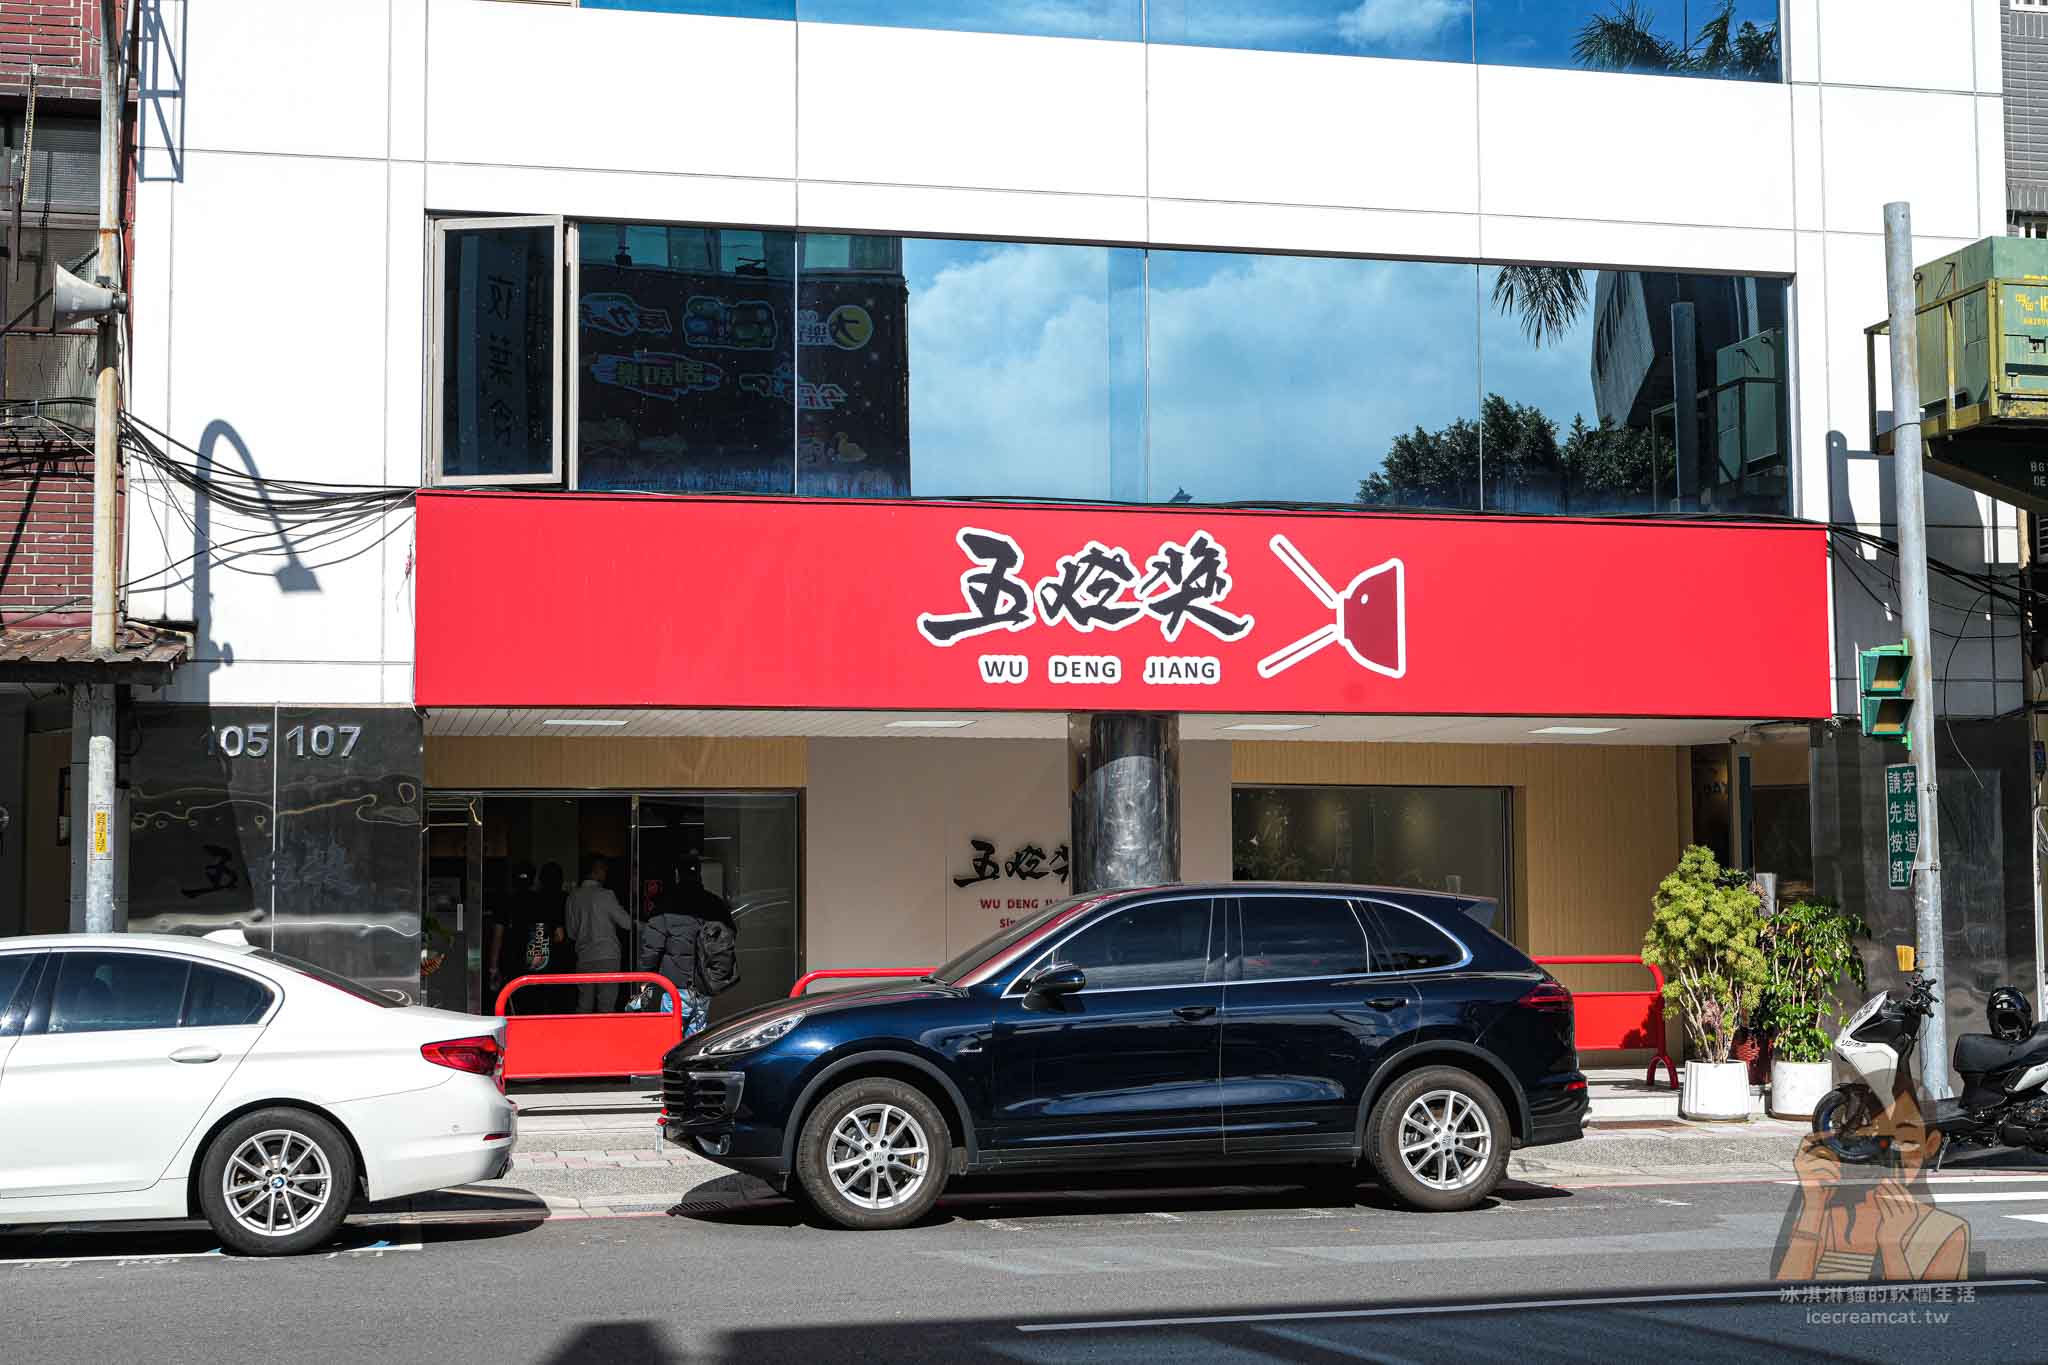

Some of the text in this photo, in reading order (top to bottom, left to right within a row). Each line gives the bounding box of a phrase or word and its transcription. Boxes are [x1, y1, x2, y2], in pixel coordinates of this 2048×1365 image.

[984, 660, 1216, 679] WU DENG JIANG
[286, 724, 361, 757] 107
[1887, 771, 1904, 883] 請先按鈕
[979, 898, 1001, 909] WU
[1007, 898, 1039, 909] DENG
